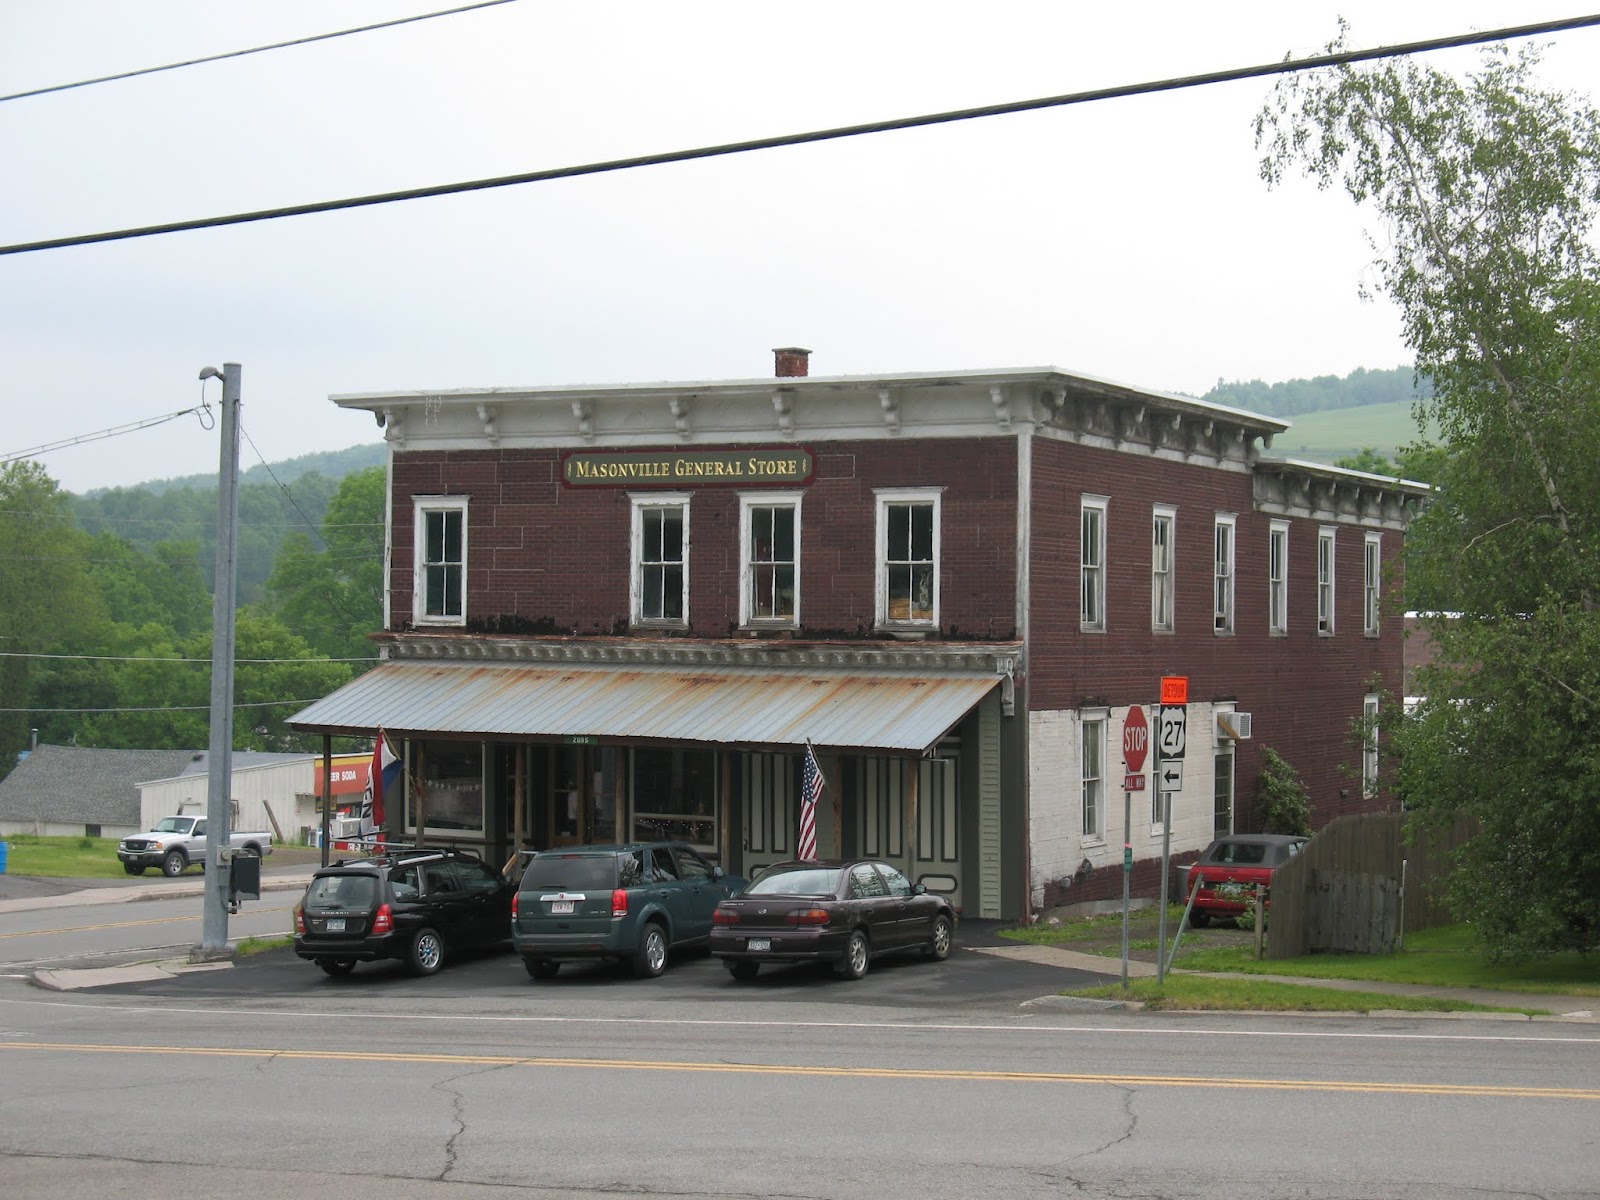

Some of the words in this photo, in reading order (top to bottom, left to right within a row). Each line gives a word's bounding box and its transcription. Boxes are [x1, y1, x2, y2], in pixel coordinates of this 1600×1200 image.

[576, 461, 670, 478] MASONVILLE
[675, 459, 743, 476] GENERAL
[748, 458, 797, 475] STORE
[1164, 683, 1185, 698] DETOUR
[1125, 727, 1147, 751] STOP
[1164, 721, 1182, 746] 27
[342, 771, 356, 781] SODA
